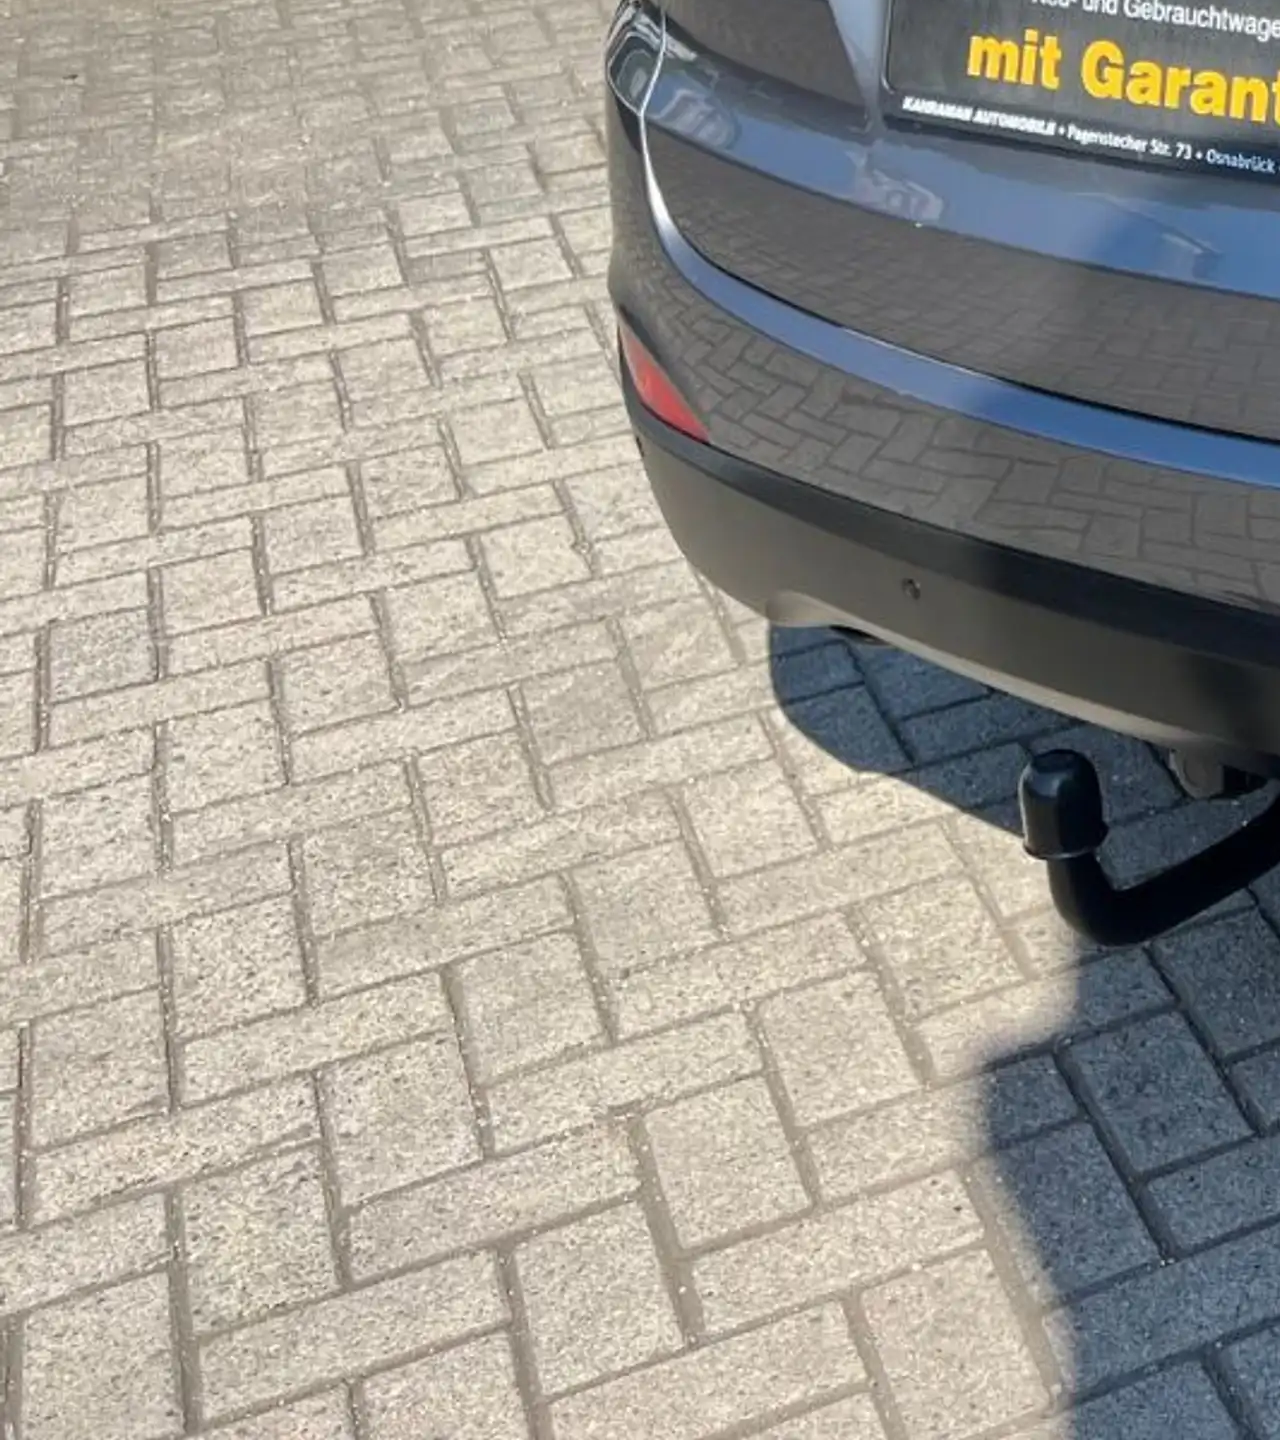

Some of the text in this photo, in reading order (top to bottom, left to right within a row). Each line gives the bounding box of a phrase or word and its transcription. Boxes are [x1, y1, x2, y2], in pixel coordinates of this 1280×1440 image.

[967, 27, 1062, 90] mit
[1067, 123, 1148, 153] Pagenstecher
[1175, 142, 1192, 160] 73
[1206, 148, 1276, 175] Osnabrück
